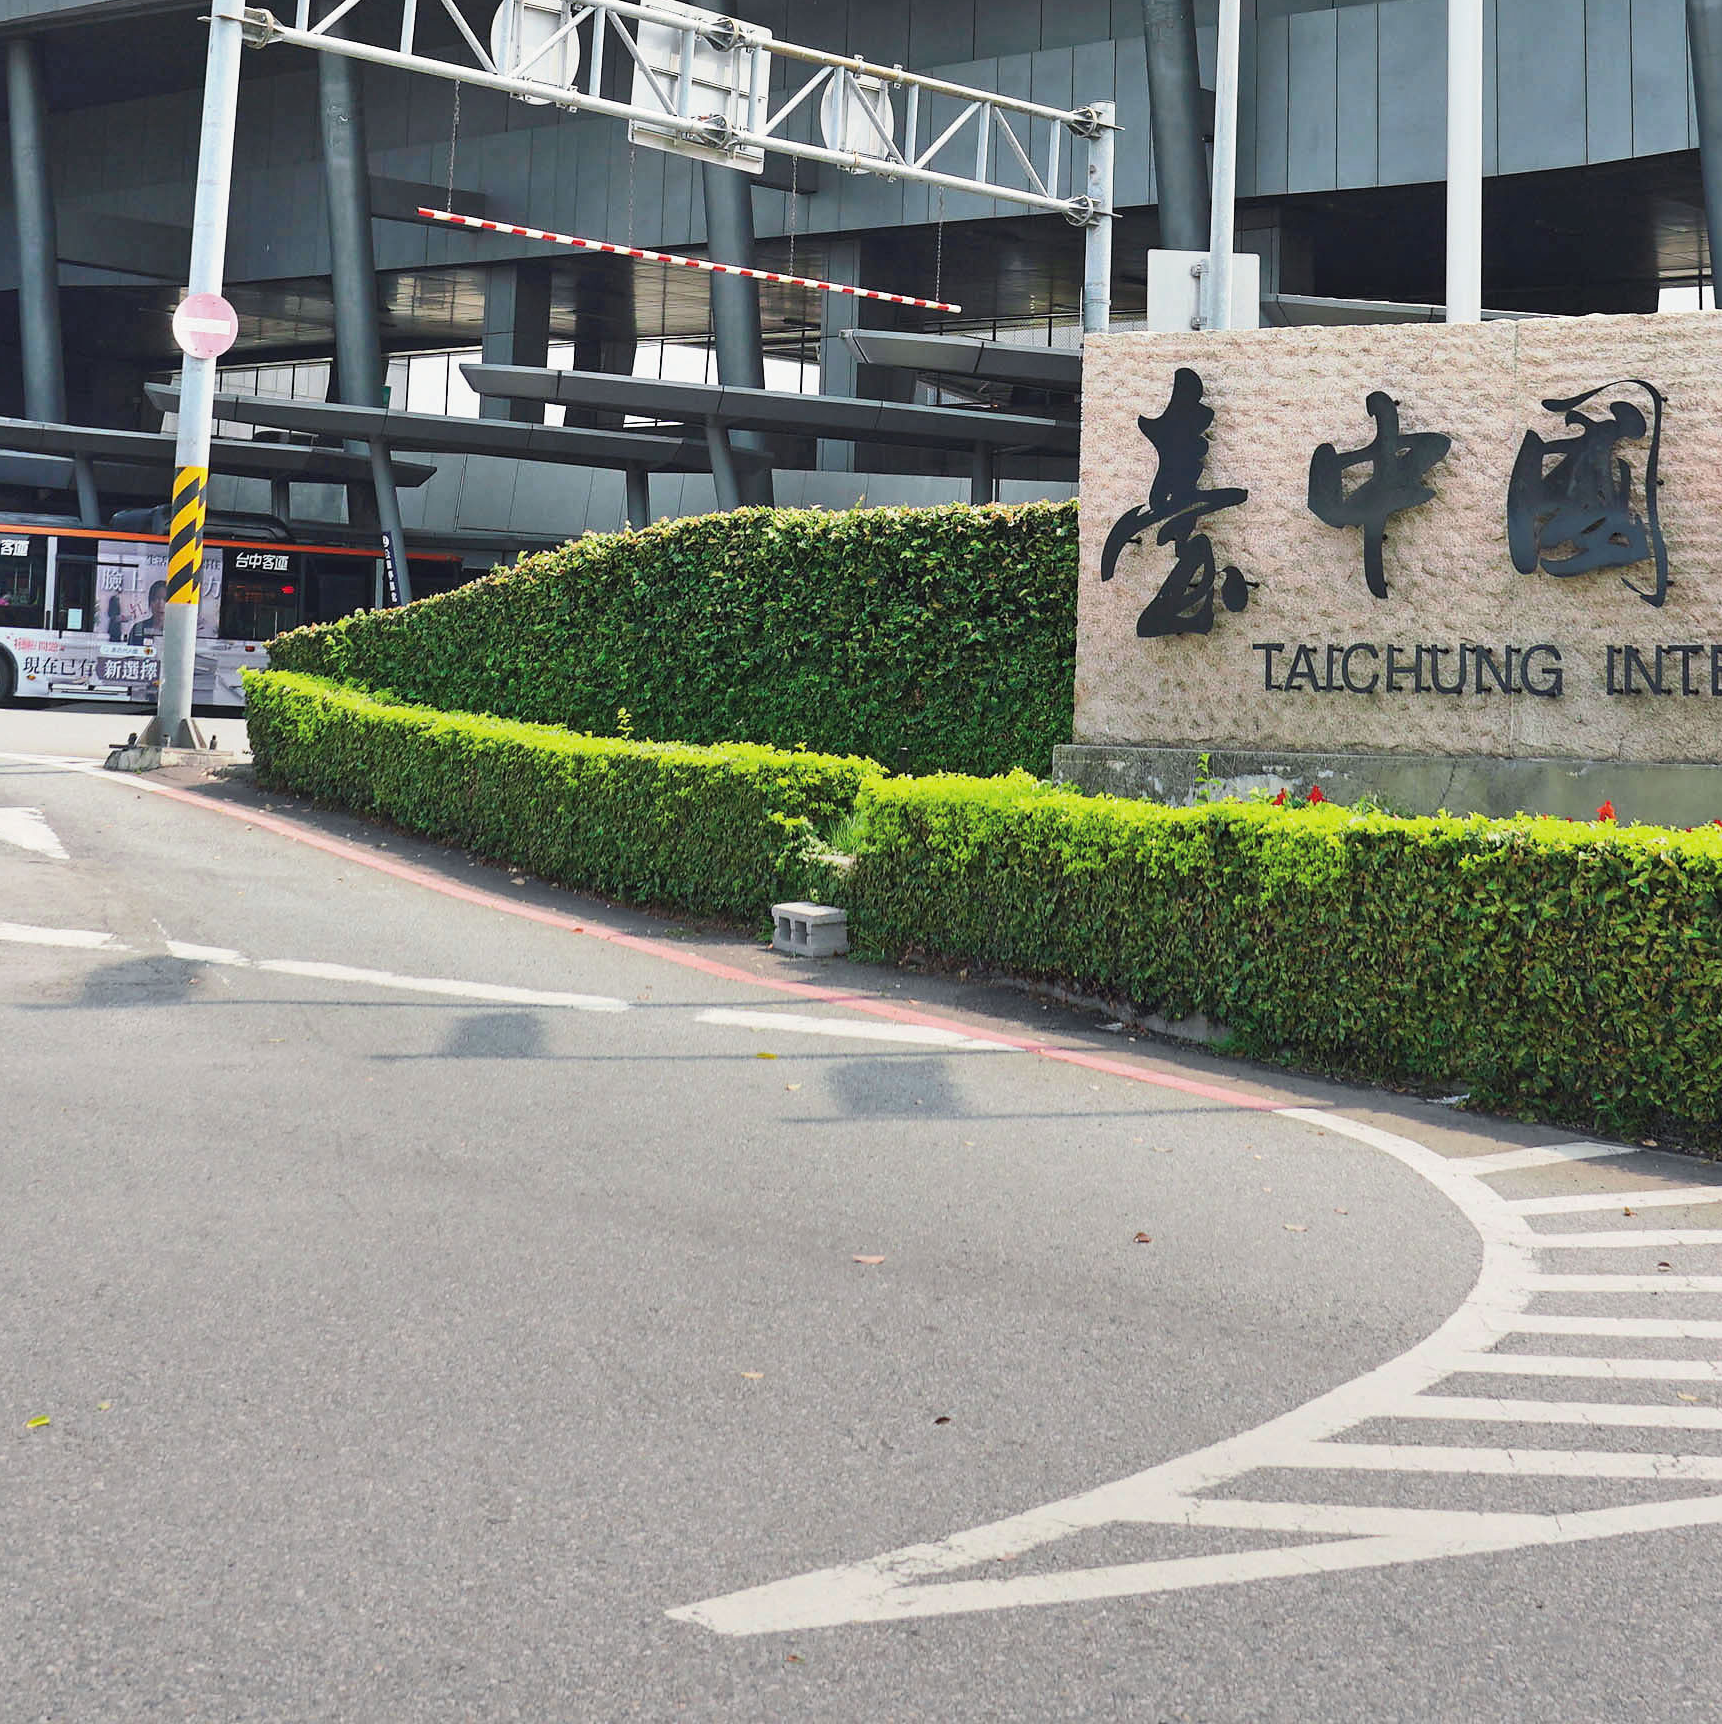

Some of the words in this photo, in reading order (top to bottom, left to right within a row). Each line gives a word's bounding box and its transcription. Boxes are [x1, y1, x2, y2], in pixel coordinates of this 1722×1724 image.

[235, 552, 290, 572] 台中客運
[1252, 642, 1565, 702] TAICHUNG
